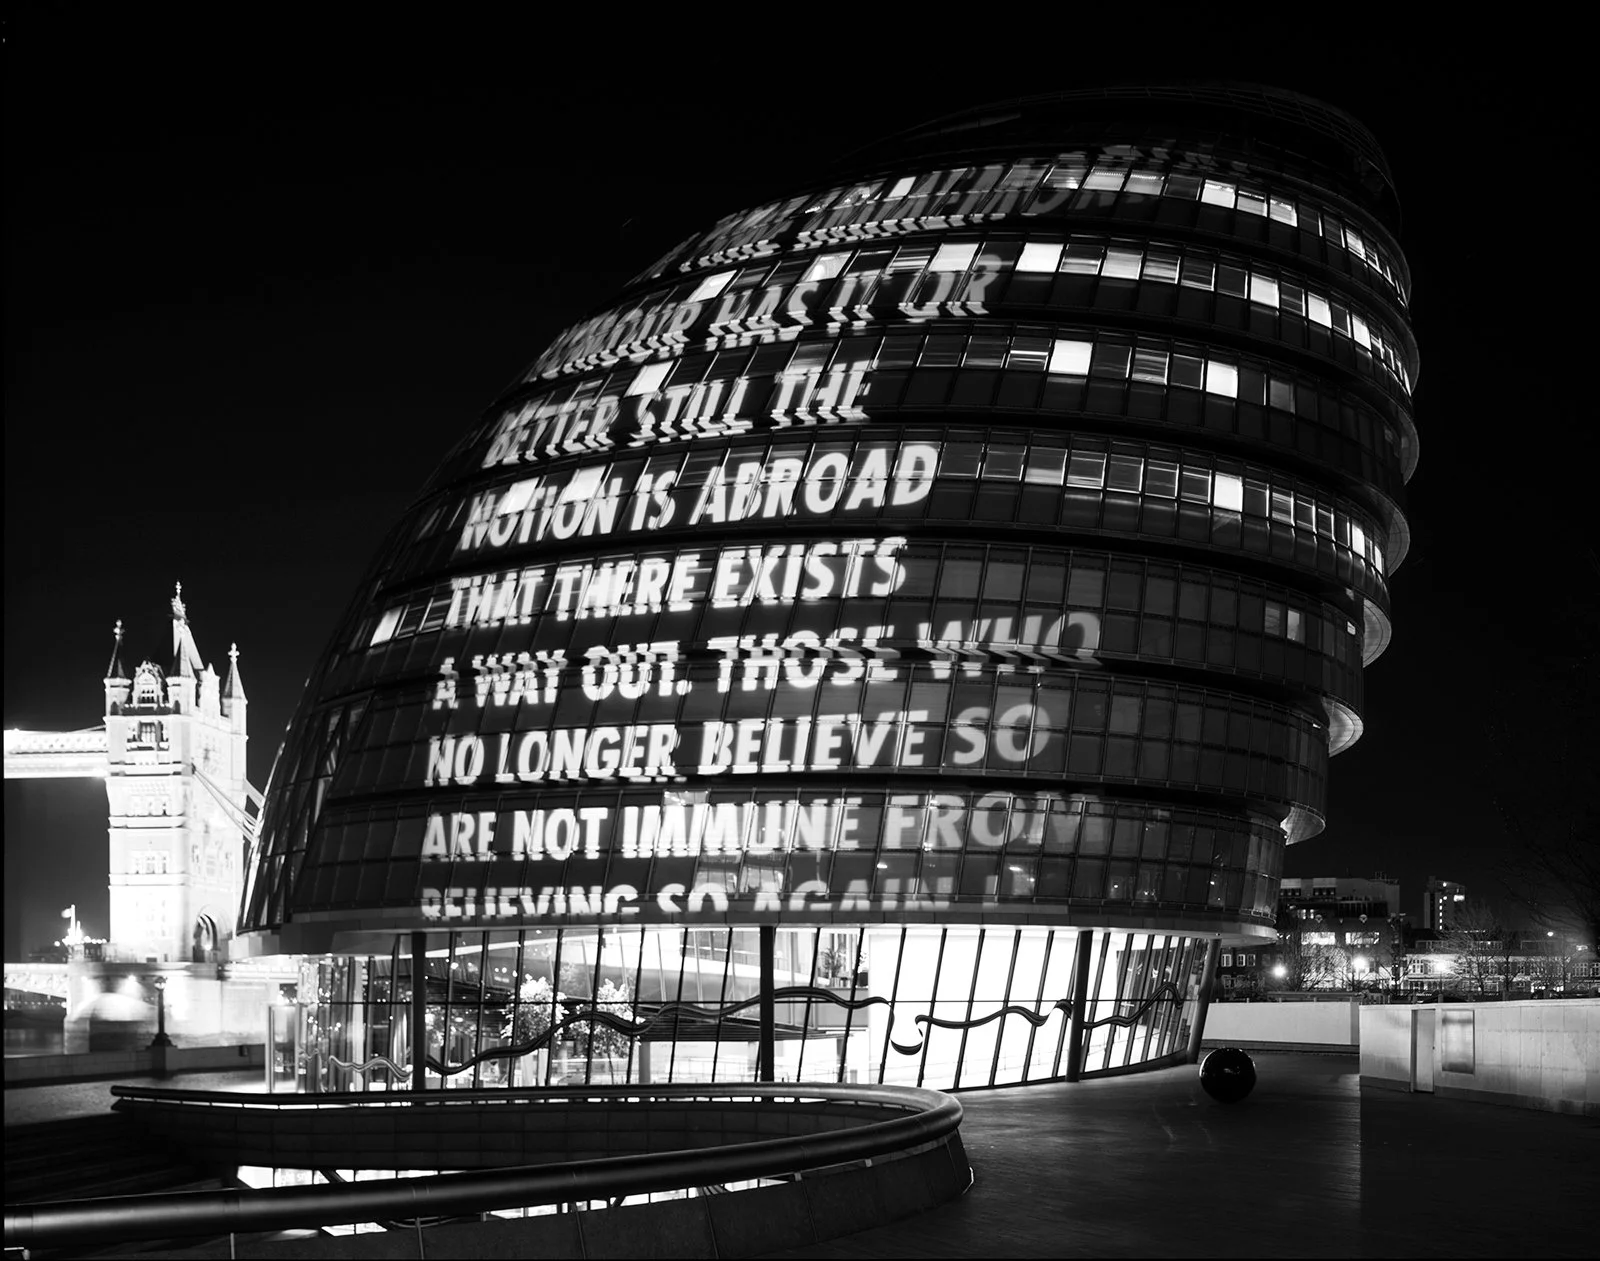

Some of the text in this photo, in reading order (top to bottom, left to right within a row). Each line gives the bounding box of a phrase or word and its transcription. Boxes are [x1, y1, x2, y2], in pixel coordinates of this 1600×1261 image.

[898, 254, 1002, 323] OR
[627, 376, 753, 446] STILL
[768, 358, 872, 428] THE
[460, 444, 938, 550] NOTION IS ABROAD
[446, 536, 907, 629] THAT THERE EXISTS
[433, 612, 1102, 709] A WAY OUT. THOSE WHO
[425, 703, 1051, 787] NO LONGER BELIEVE SO
[420, 789, 1106, 861] ARE NOT IMMUNE FROM
